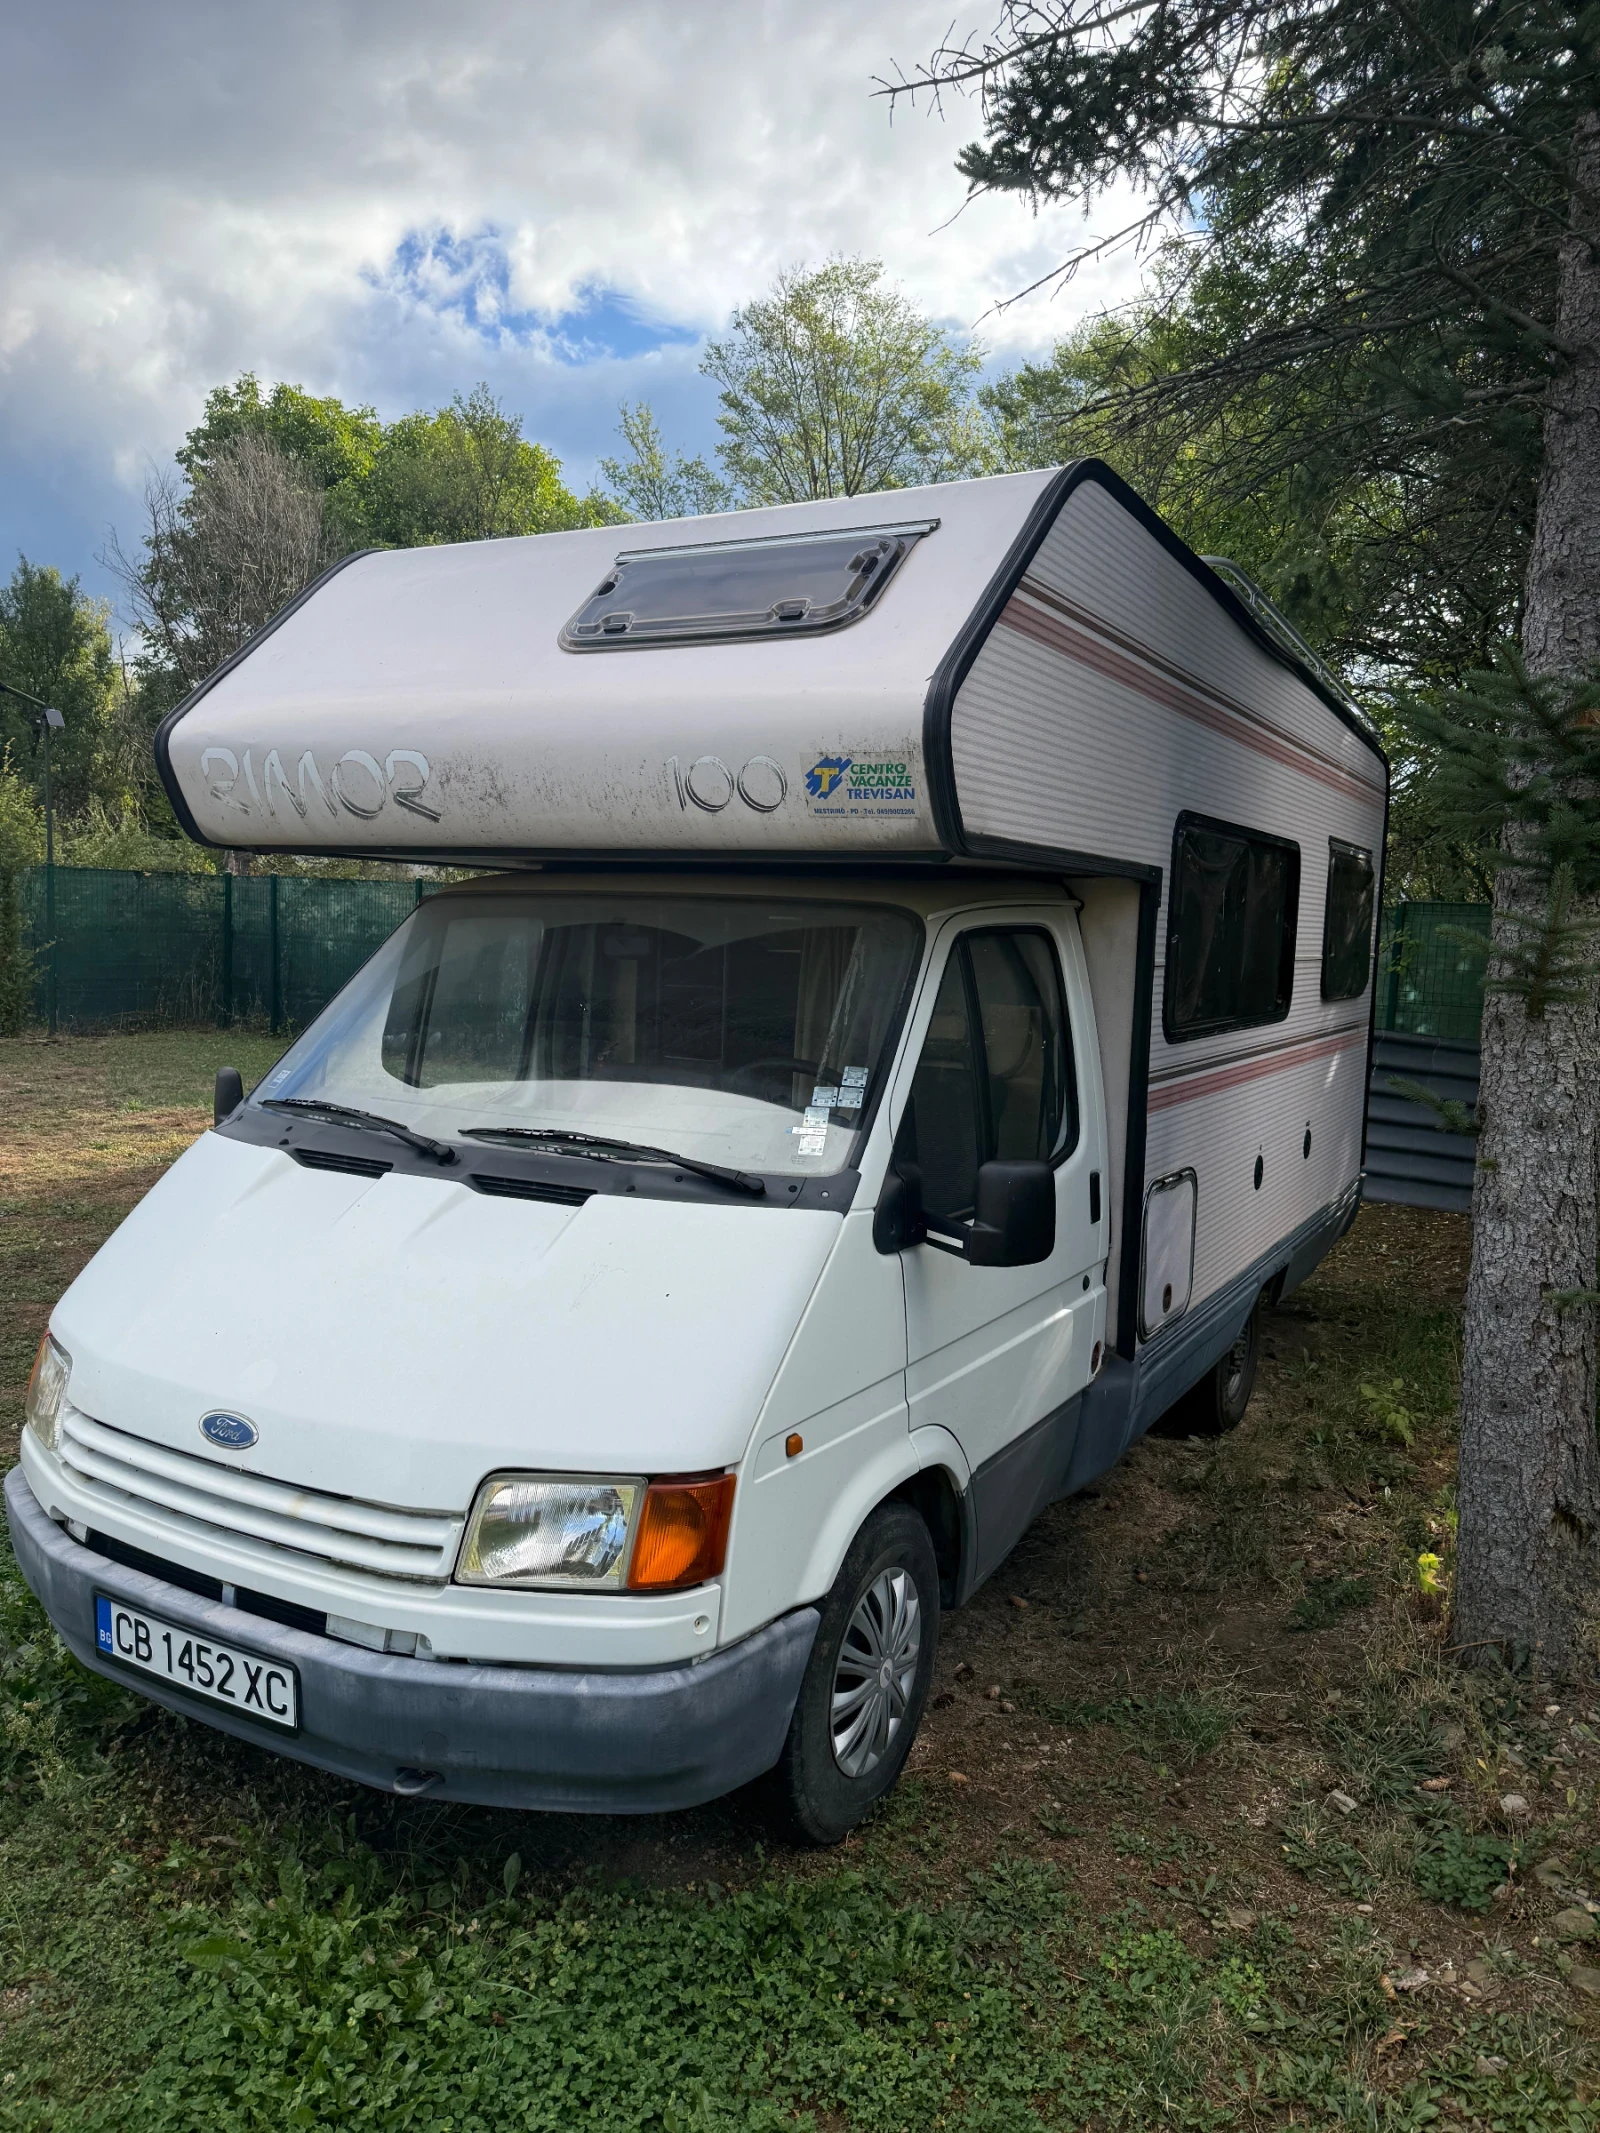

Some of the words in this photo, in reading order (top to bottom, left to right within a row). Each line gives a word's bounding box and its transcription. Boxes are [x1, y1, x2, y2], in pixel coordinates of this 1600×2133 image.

[850, 763, 907, 775] CENTRO
[200, 748, 442, 823] RIMOR
[663, 755, 788, 813] 100
[849, 775, 912, 787] VACANZE
[847, 788, 915, 800] TREVISAN
[210, 1417, 244, 1441] Ford
[99, 1628, 112, 1644] BG
[115, 1611, 153, 1663] CB
[161, 1631, 237, 1699] 1452
[243, 1660, 288, 1716] XC
